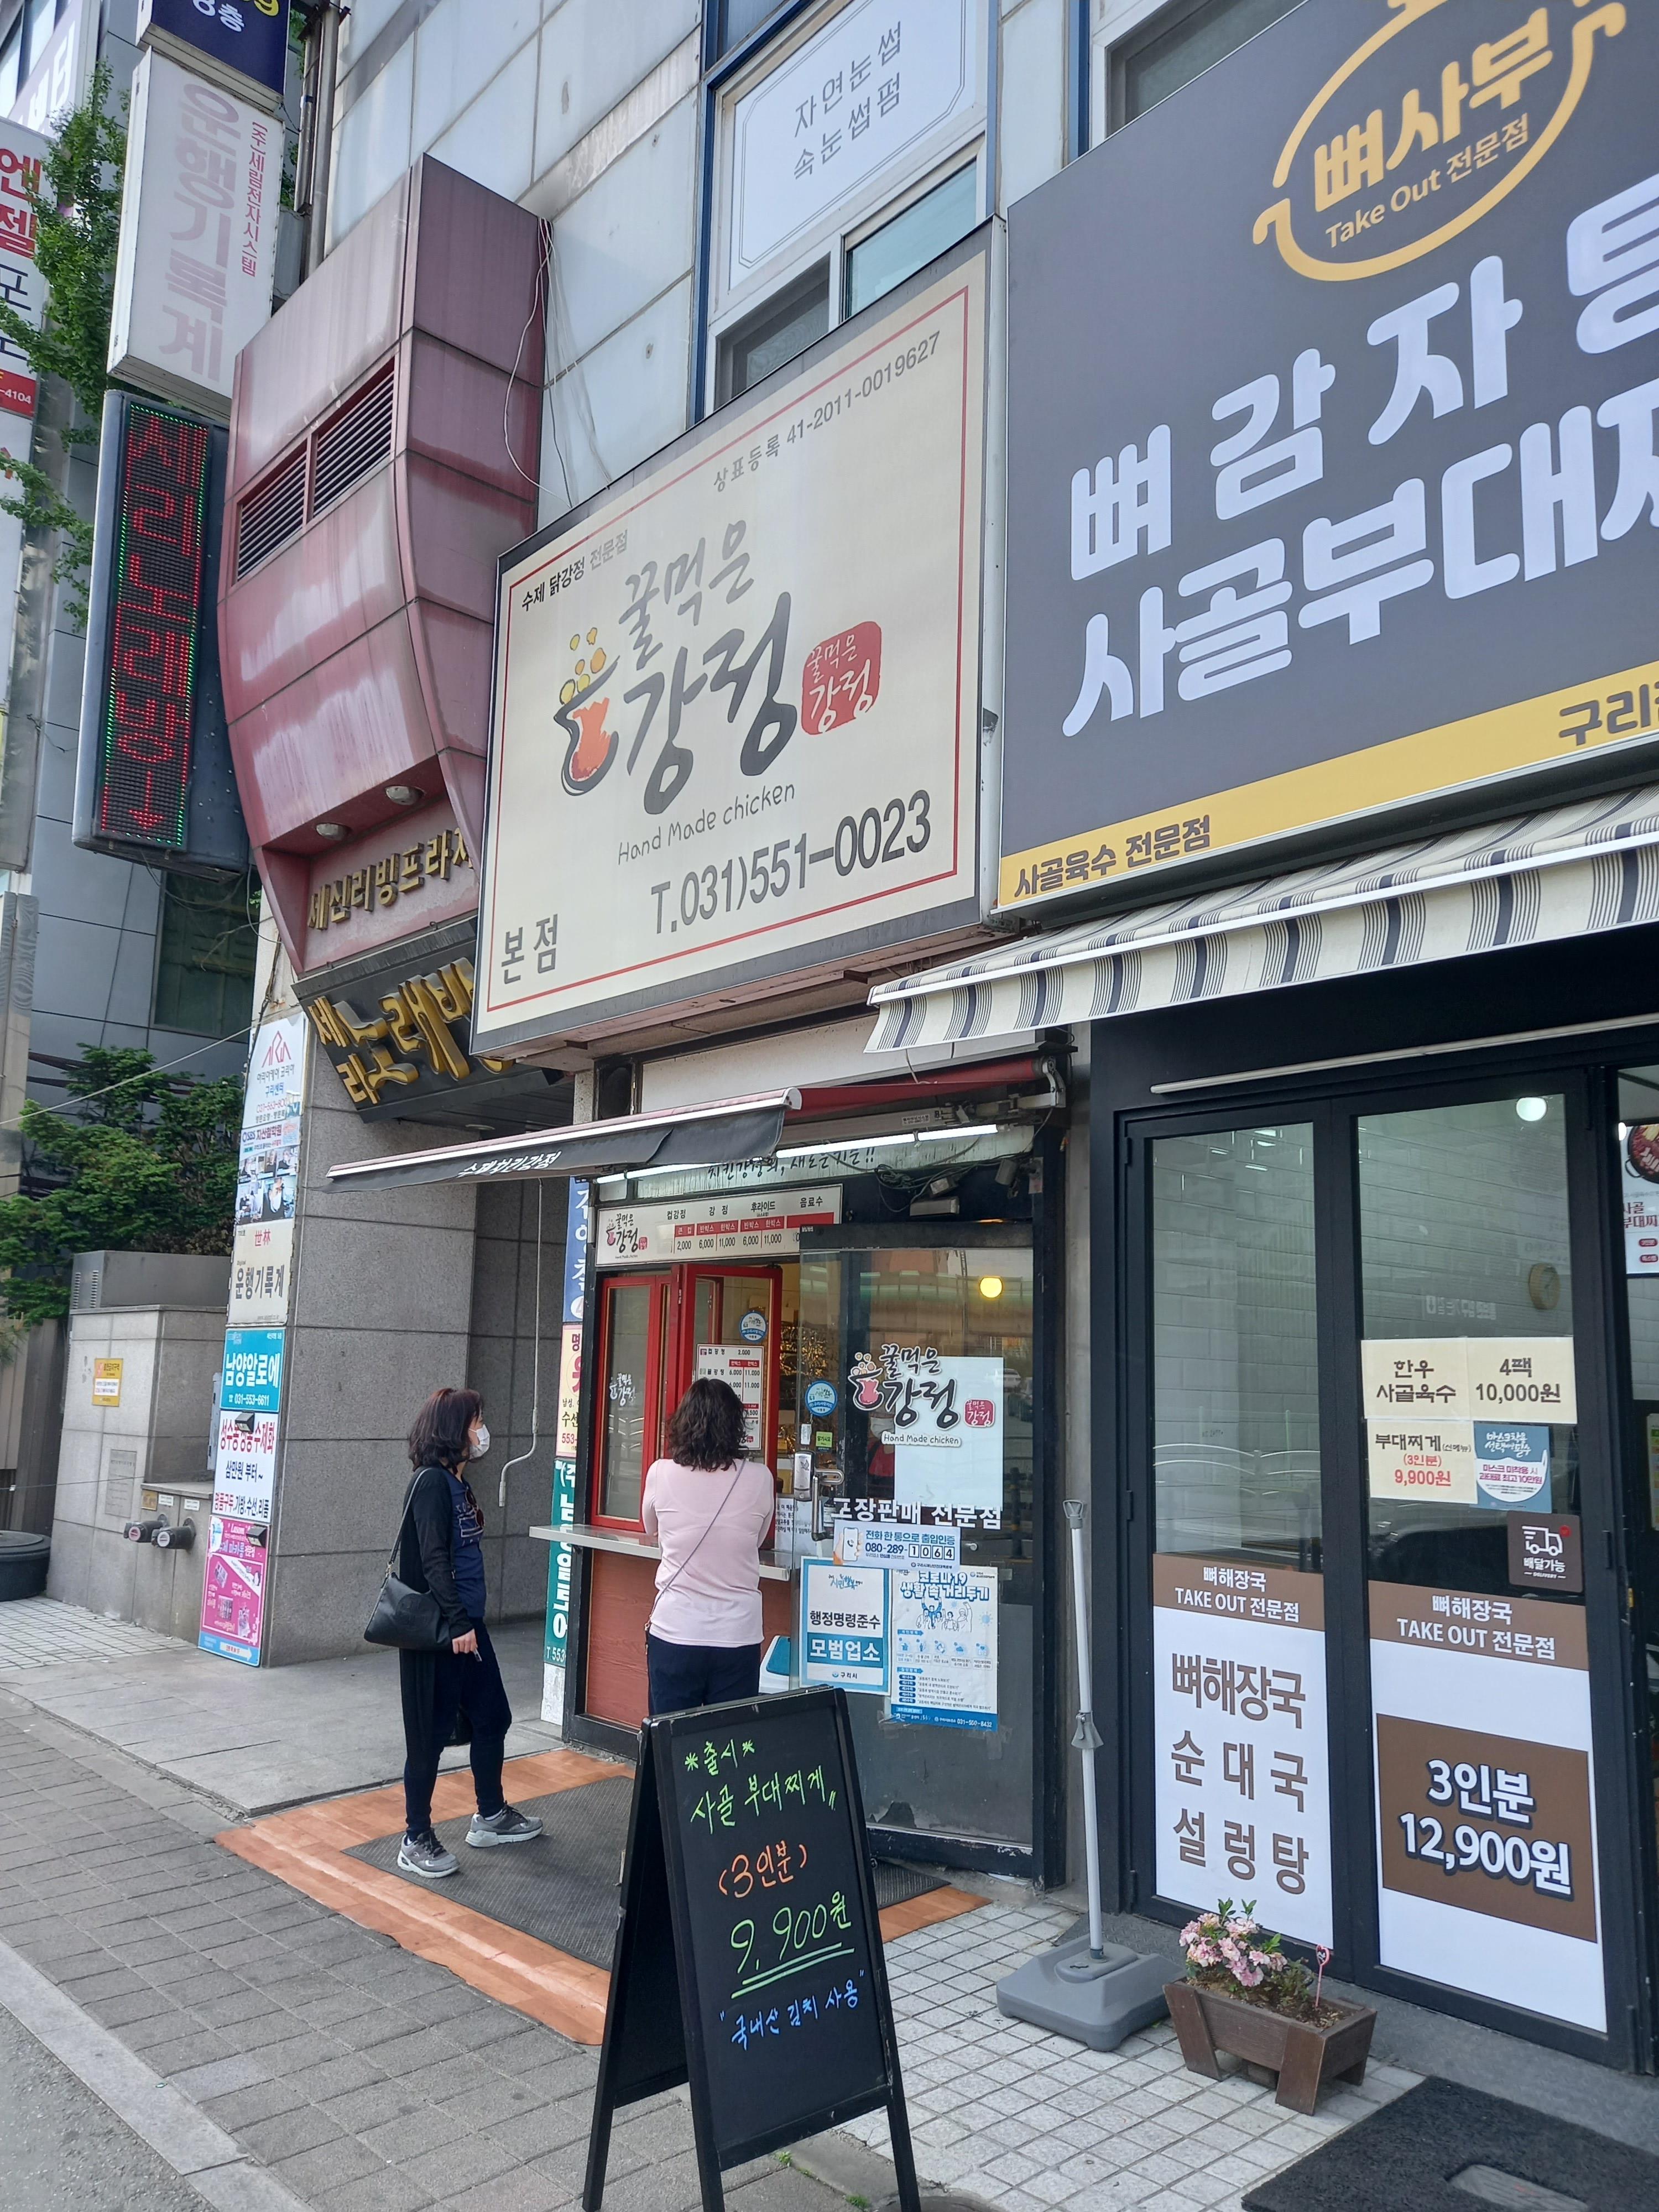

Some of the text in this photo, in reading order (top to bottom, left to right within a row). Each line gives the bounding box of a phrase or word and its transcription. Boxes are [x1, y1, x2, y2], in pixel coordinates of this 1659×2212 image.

[794, 20, 901, 138] 자연눈썹
[793, 72, 900, 180] 속눈썹펌
[1313, 8, 1553, 212] 뼈사부
[1326, 113, 1529, 248] Take Out 전문점
[714, 331, 941, 494] 상표등록 41-2011-0019627
[521, 529, 628, 612] 수제 닭강정 전문점
[618, 520, 754, 671] 꿀먹은
[806, 634, 857, 679] 꿀먹은
[623, 591, 798, 816] 강정
[617, 781, 796, 867] Hand Made chicken
[650, 790, 932, 936] T.031)551-0023
[1014, 815, 1212, 898] 사골육수 전문점
[500, 914, 559, 985] 본점
[750, 1201, 776, 1213] 후라이드
[800, 1196, 823, 1208] 음료수
[677, 1233, 782, 1251] 2,000 6,000 11,000 6,000 11,000
[235, 1264, 285, 1300] 운행기록계
[225, 1353, 280, 1388] 남양알로에
[880, 1344, 941, 1379] 꿀먹은
[1394, 1358, 1532, 1379] 한우 4팩
[884, 1379, 960, 1431] 강정
[1376, 1383, 1561, 1404] 사골육수 10,000원
[884, 1433, 959, 1445] Hand Made chicken
[1404, 1453, 1442, 1467] (3인분)
[226, 1459, 244, 1480] 삼만원
[1395, 1469, 1452, 1486] 9,900원
[865, 1530, 883, 1541] 전화
[894, 1532, 920, 1543] 통으로
[921, 1533, 956, 1546] 출입인증
[931, 1503, 1002, 1531] 전문점
[1203, 1566, 1267, 1593] 뼈해장국
[1523, 1557, 1566, 1573] 배달가능
[900, 1581, 926, 1599] 생활
[943, 1584, 990, 1602] 거리두기
[1175, 1587, 1300, 1624] TAKE OUT 전문점
[1431, 1594, 1513, 1625] 뼈해장국
[810, 1610, 881, 1630] 행정명령준수
[1396, 1618, 1556, 1661] TAKE OUT 전문점
[810, 1638, 881, 1662] 모범업소
[840, 1671, 858, 1679] 구리시
[1172, 1652, 1306, 1730] 뼈해장국
[1170, 1729, 1309, 1813] 순대국
[1427, 1758, 1535, 1824] 3인분
[690, 1778, 736, 1834] 사골
[718, 1840, 808, 1898] (3인분)
[1172, 1807, 1310, 1895] 설렁탕
[1399, 1812, 1572, 1896] 12,900원
